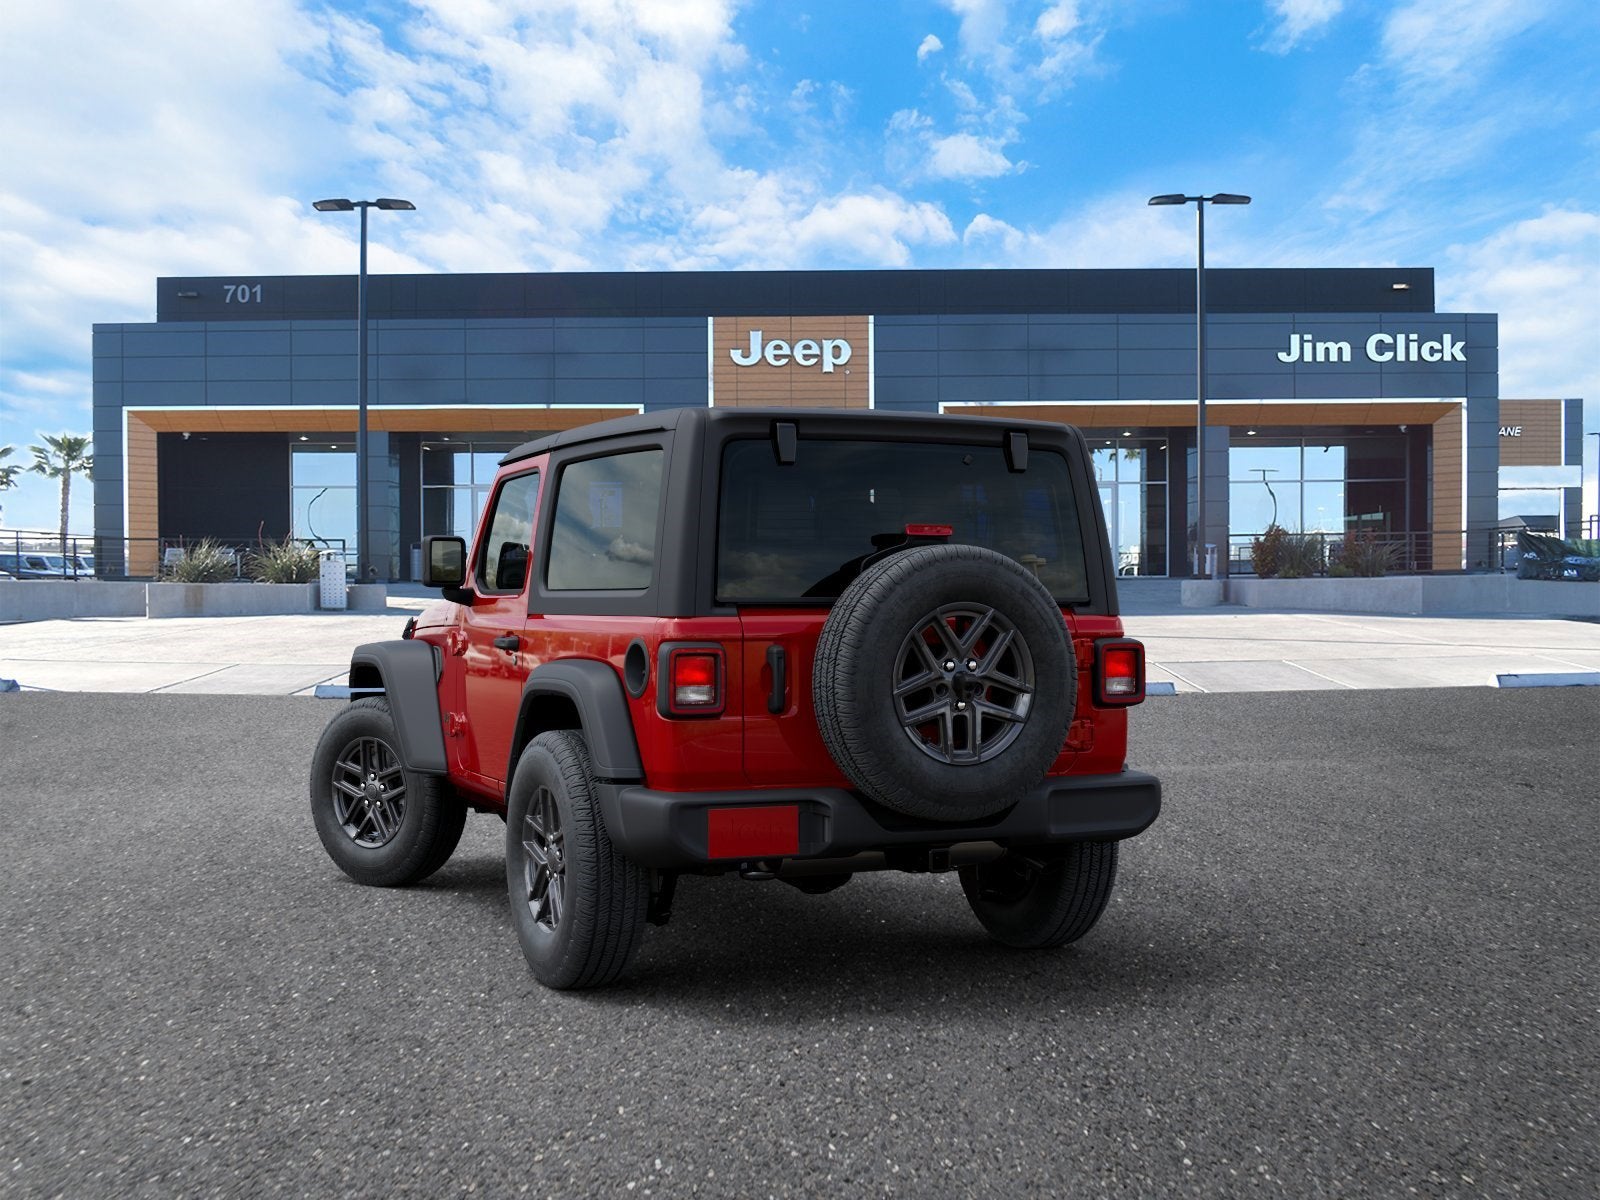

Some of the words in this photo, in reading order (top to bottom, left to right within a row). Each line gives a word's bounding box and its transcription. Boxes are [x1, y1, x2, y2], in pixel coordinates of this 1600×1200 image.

[223, 284, 262, 304] 701
[729, 329, 853, 374] Jeep
[1277, 333, 1351, 363] Jim
[1366, 332, 1467, 363] Click
